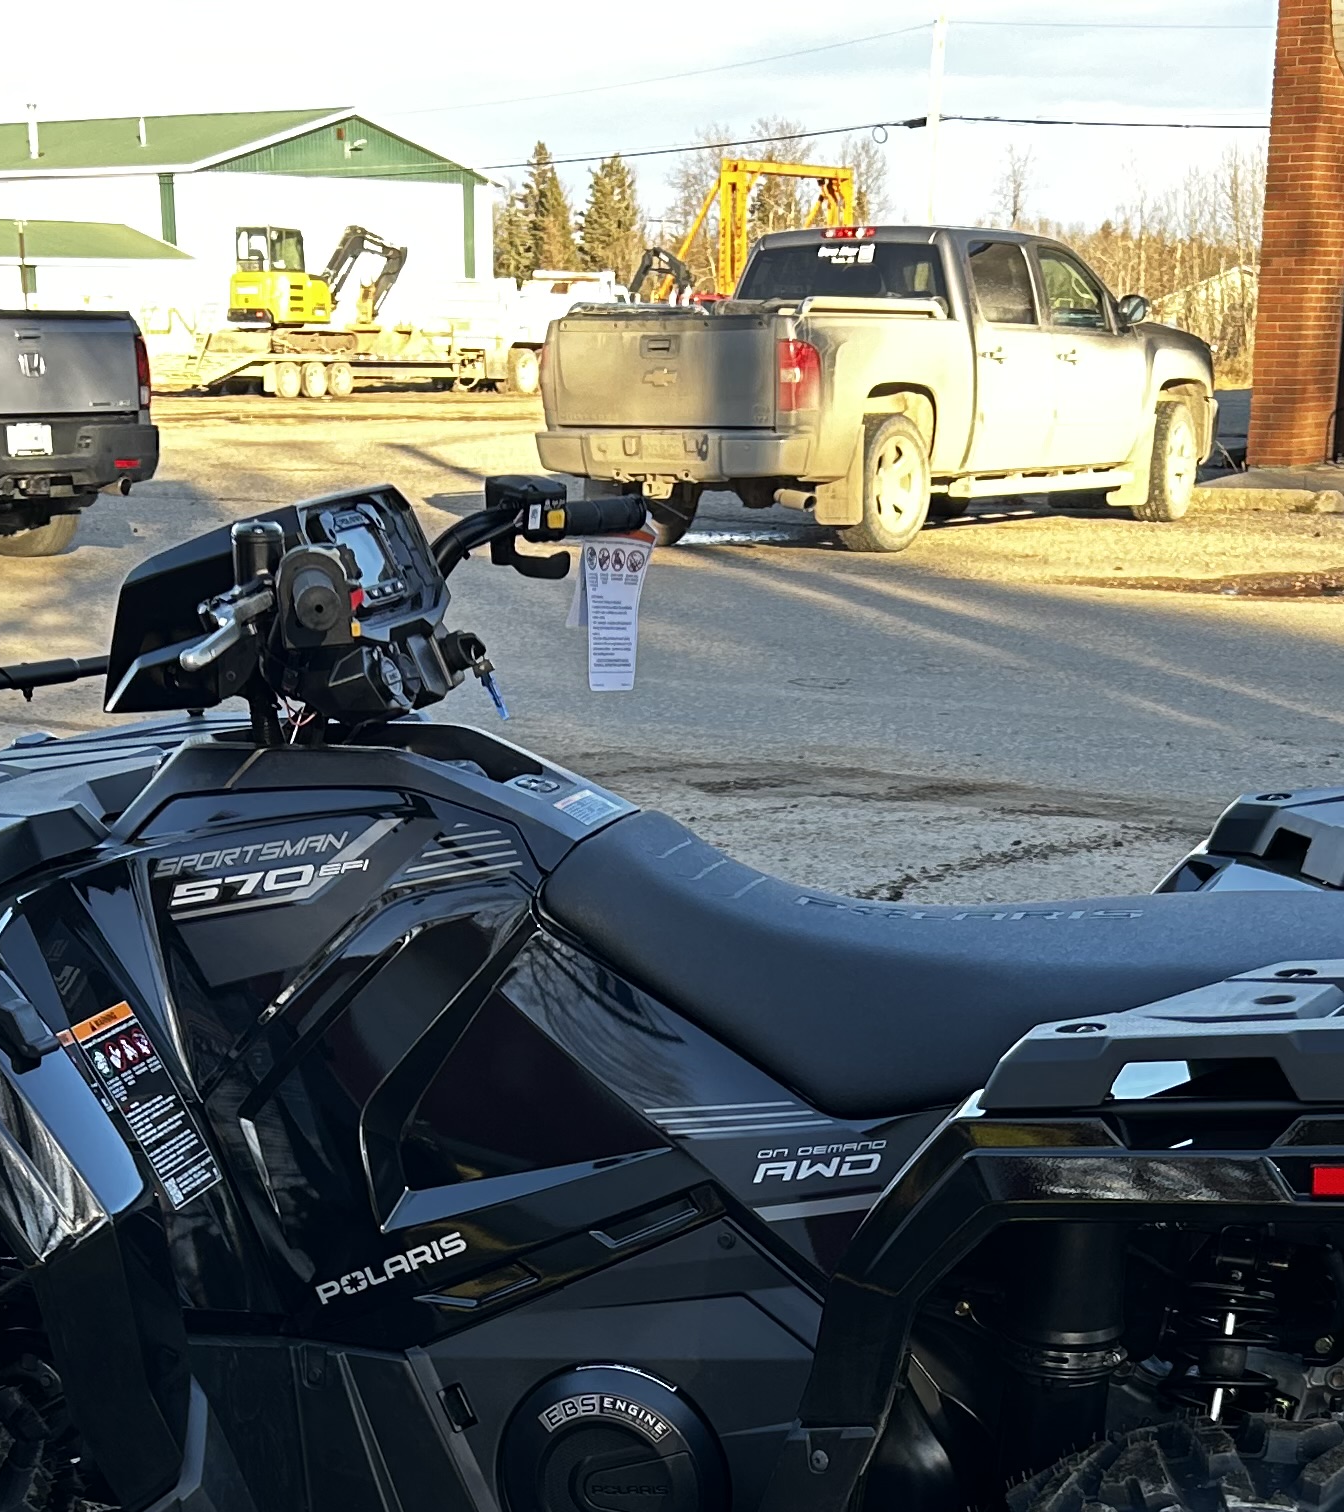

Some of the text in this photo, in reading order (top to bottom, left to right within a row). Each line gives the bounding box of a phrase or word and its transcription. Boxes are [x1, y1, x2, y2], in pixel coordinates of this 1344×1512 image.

[153, 830, 348, 878] SPORTSMAN
[171, 858, 370, 907] 570 EFI
[794, 895, 1145, 921] POLARIS
[757, 1140, 887, 1159] ON DEMAND
[752, 1153, 881, 1184] AWD
[315, 1231, 467, 1305] POLARIS
[545, 1396, 667, 1435] EBS ENGINE
[591, 1484, 669, 1495] POLARIS
